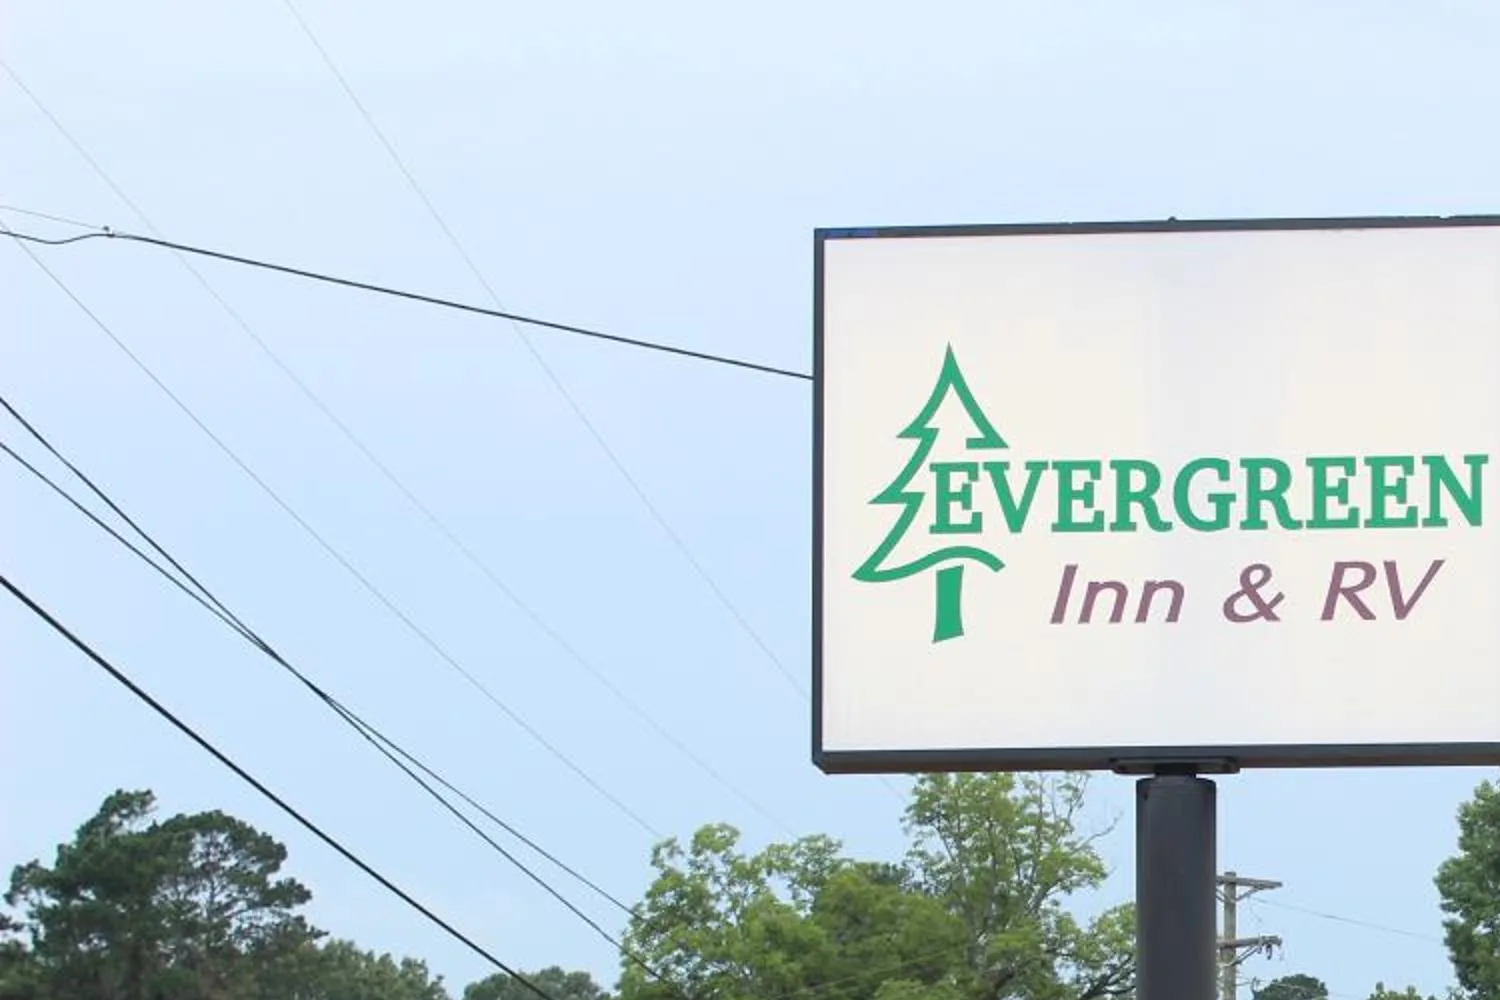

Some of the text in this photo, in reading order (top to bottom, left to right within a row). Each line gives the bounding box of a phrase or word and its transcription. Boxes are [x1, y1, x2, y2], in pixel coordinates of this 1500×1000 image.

[929, 454, 1488, 534] EVERGREEN
[1051, 560, 1444, 624] Inn & RV
